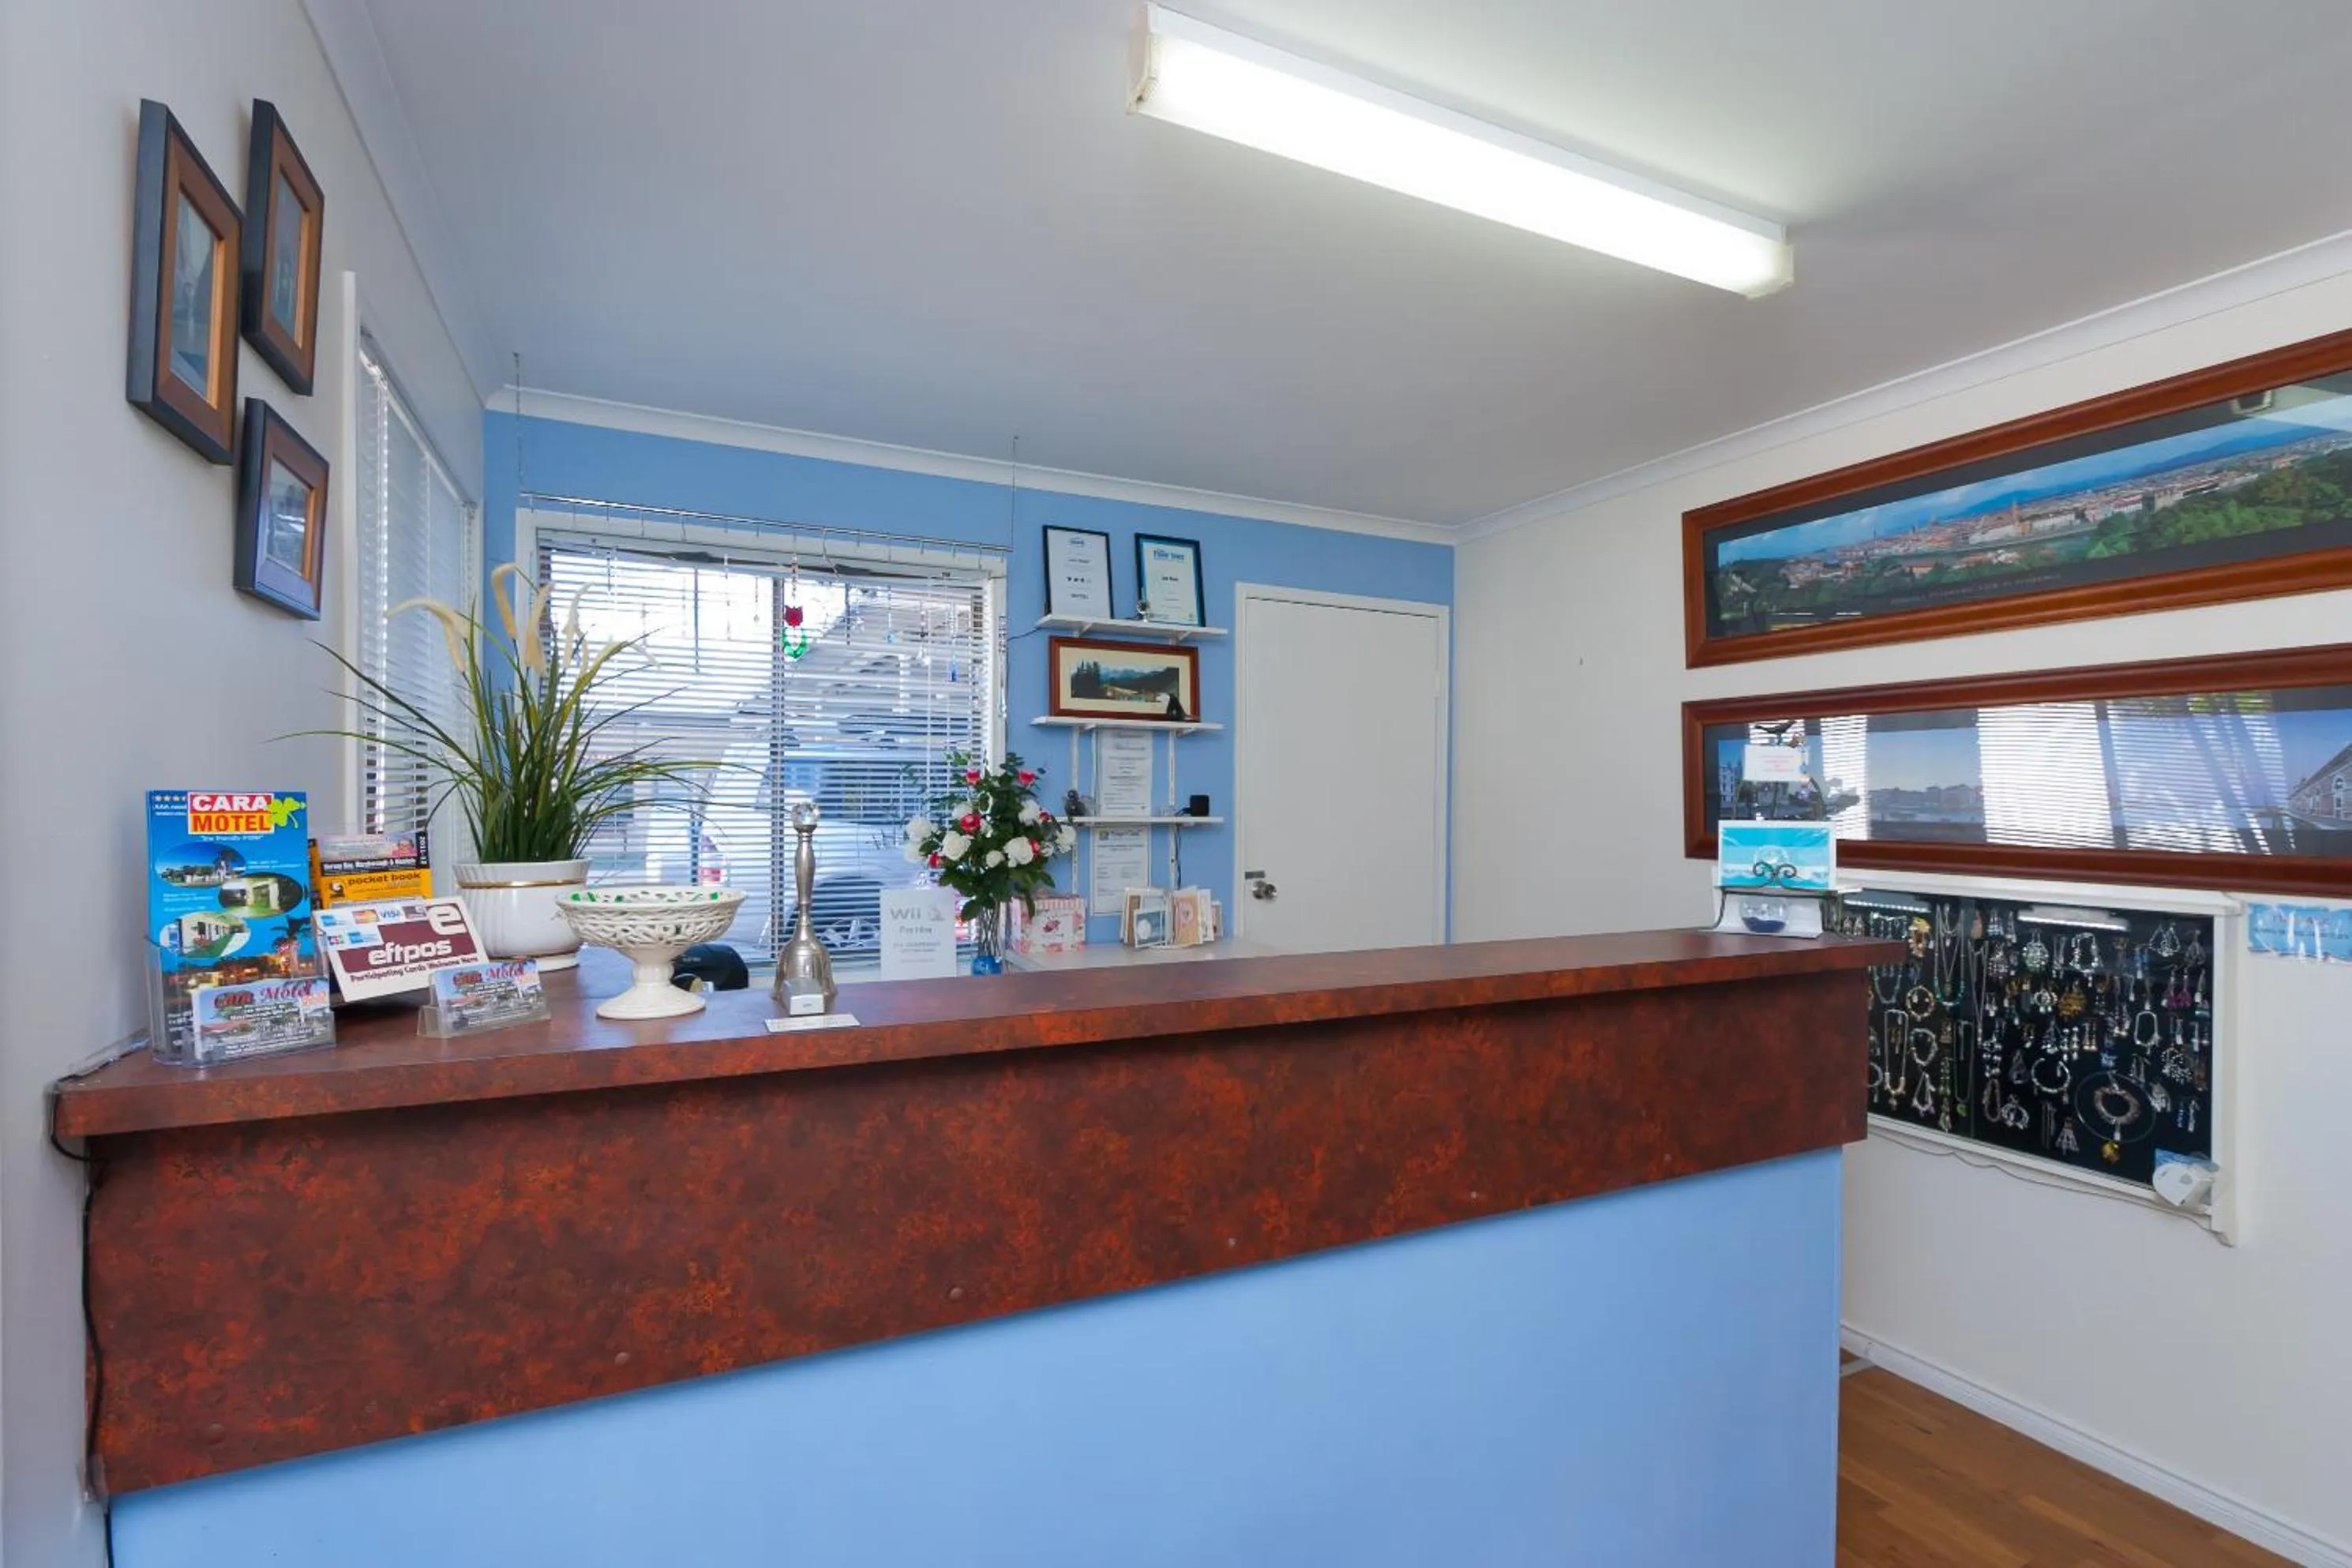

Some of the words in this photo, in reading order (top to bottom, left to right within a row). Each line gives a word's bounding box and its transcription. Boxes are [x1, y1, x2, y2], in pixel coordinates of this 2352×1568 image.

[192, 795, 268, 812] CARA
[192, 814, 270, 832] MOTEL
[347, 876, 388, 886] pocket
[391, 872, 422, 882] book
[890, 906, 921, 920] Wii
[368, 939, 452, 965] eftpos
[350, 966, 404, 982] Participating
[404, 964, 426, 976] Cards
[260, 978, 313, 1001] Motel
